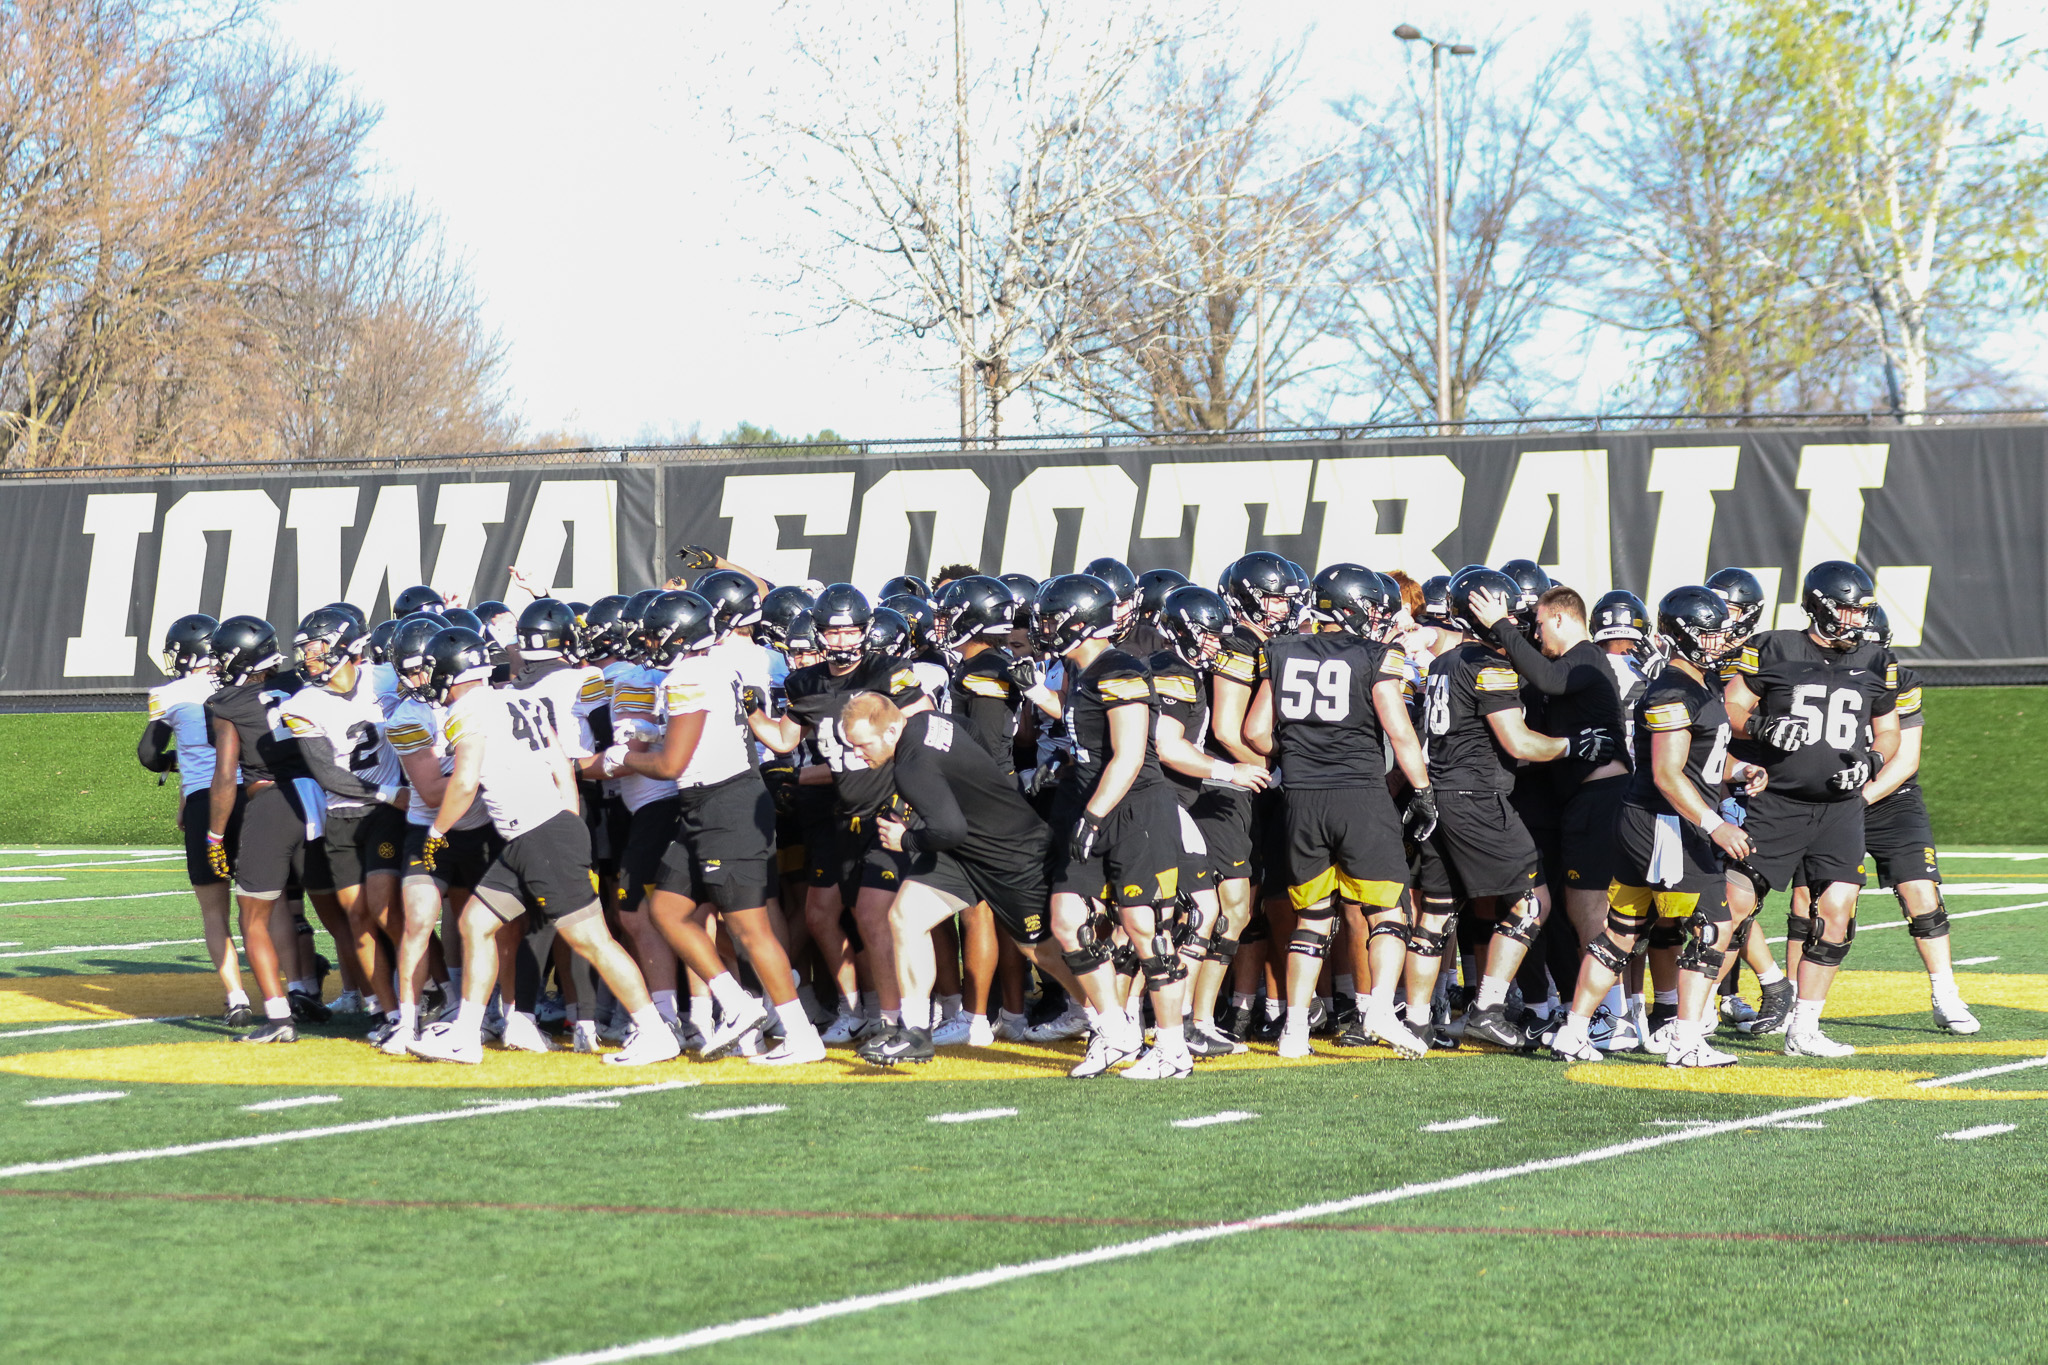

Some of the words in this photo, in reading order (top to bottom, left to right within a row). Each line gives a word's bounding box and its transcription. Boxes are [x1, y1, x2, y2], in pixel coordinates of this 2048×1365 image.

[63, 480, 617, 677] IOWA
[719, 443, 1932, 647] FOOTBALL
[1281, 658, 1351, 721] 59
[1790, 684, 1863, 751] 56
